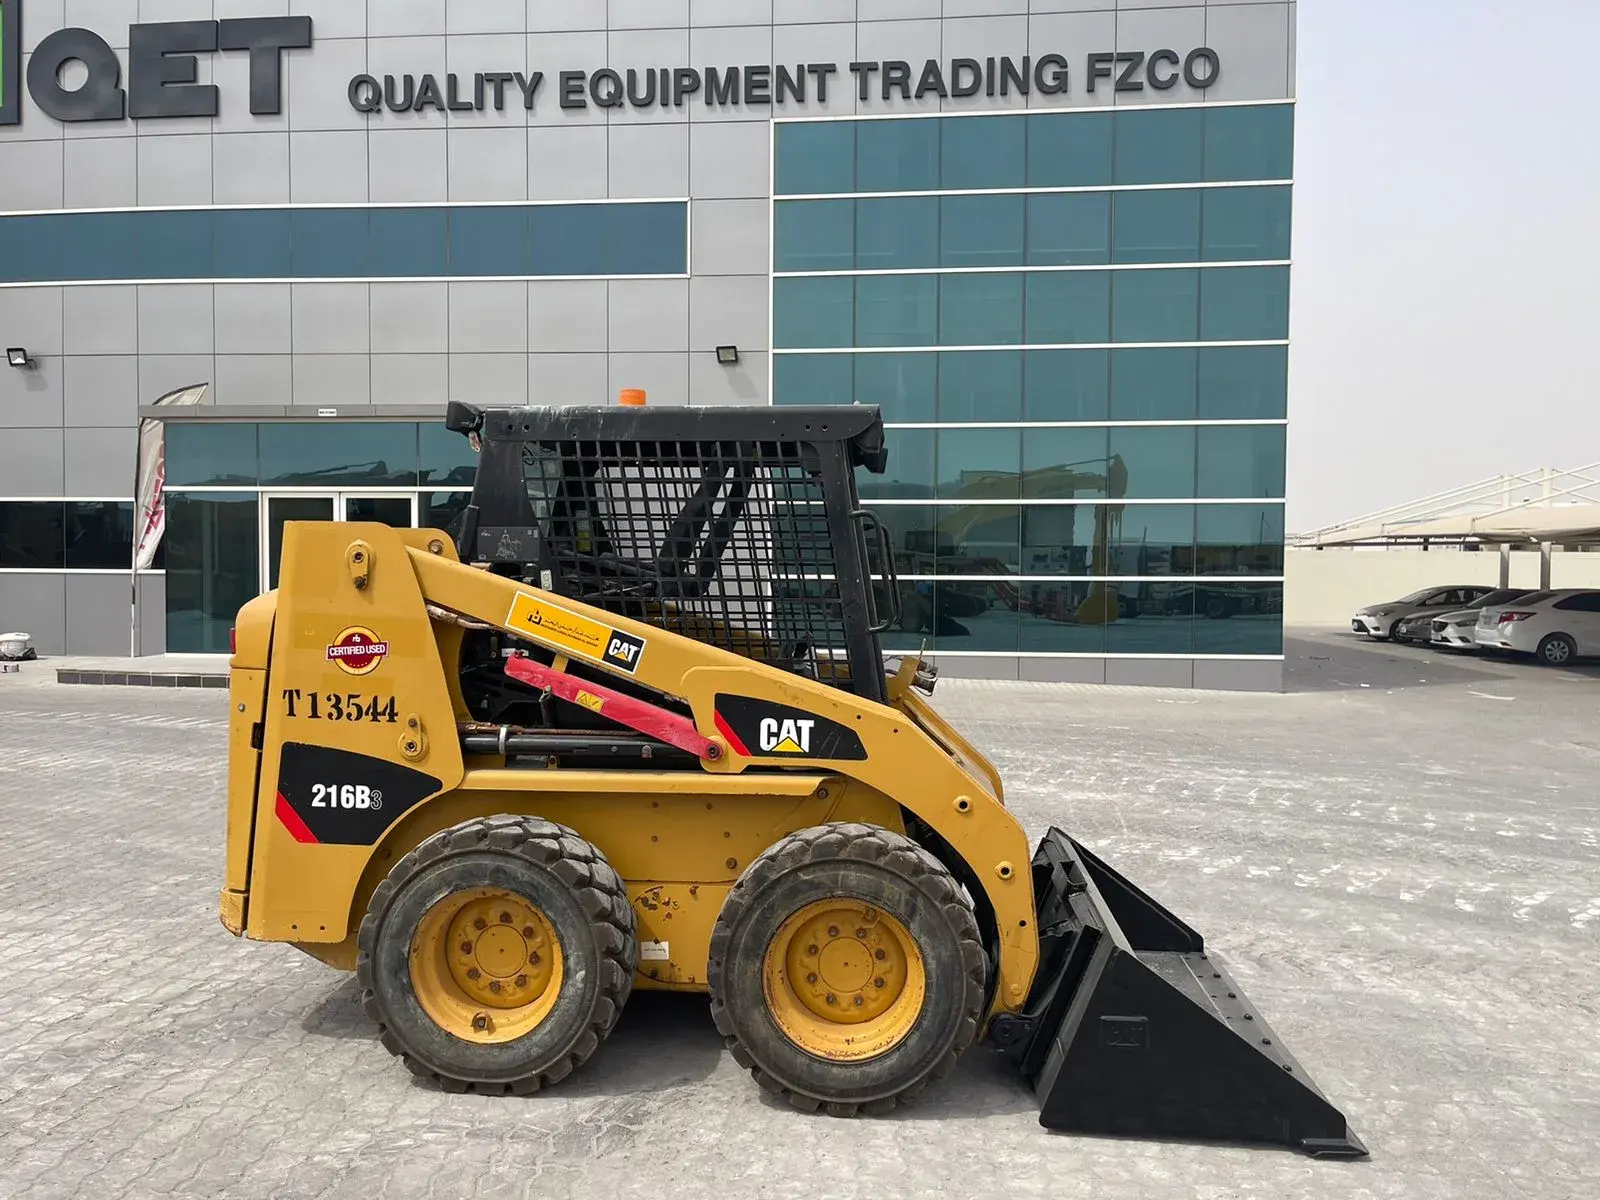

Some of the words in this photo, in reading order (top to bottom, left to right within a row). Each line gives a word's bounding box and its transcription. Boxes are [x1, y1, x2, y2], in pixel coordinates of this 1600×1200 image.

[27, 16, 312, 123] QET
[347, 71, 543, 114] QUALITY
[559, 64, 836, 109] EQUIPMENT
[850, 53, 1069, 101] TRADING
[1086, 47, 1220, 93] FZCO
[329, 646, 365, 656] CERTIFIED
[366, 644, 385, 654] USED
[608, 638, 638, 662] CAT
[282, 689, 399, 723] T13544
[759, 717, 814, 753] CAT
